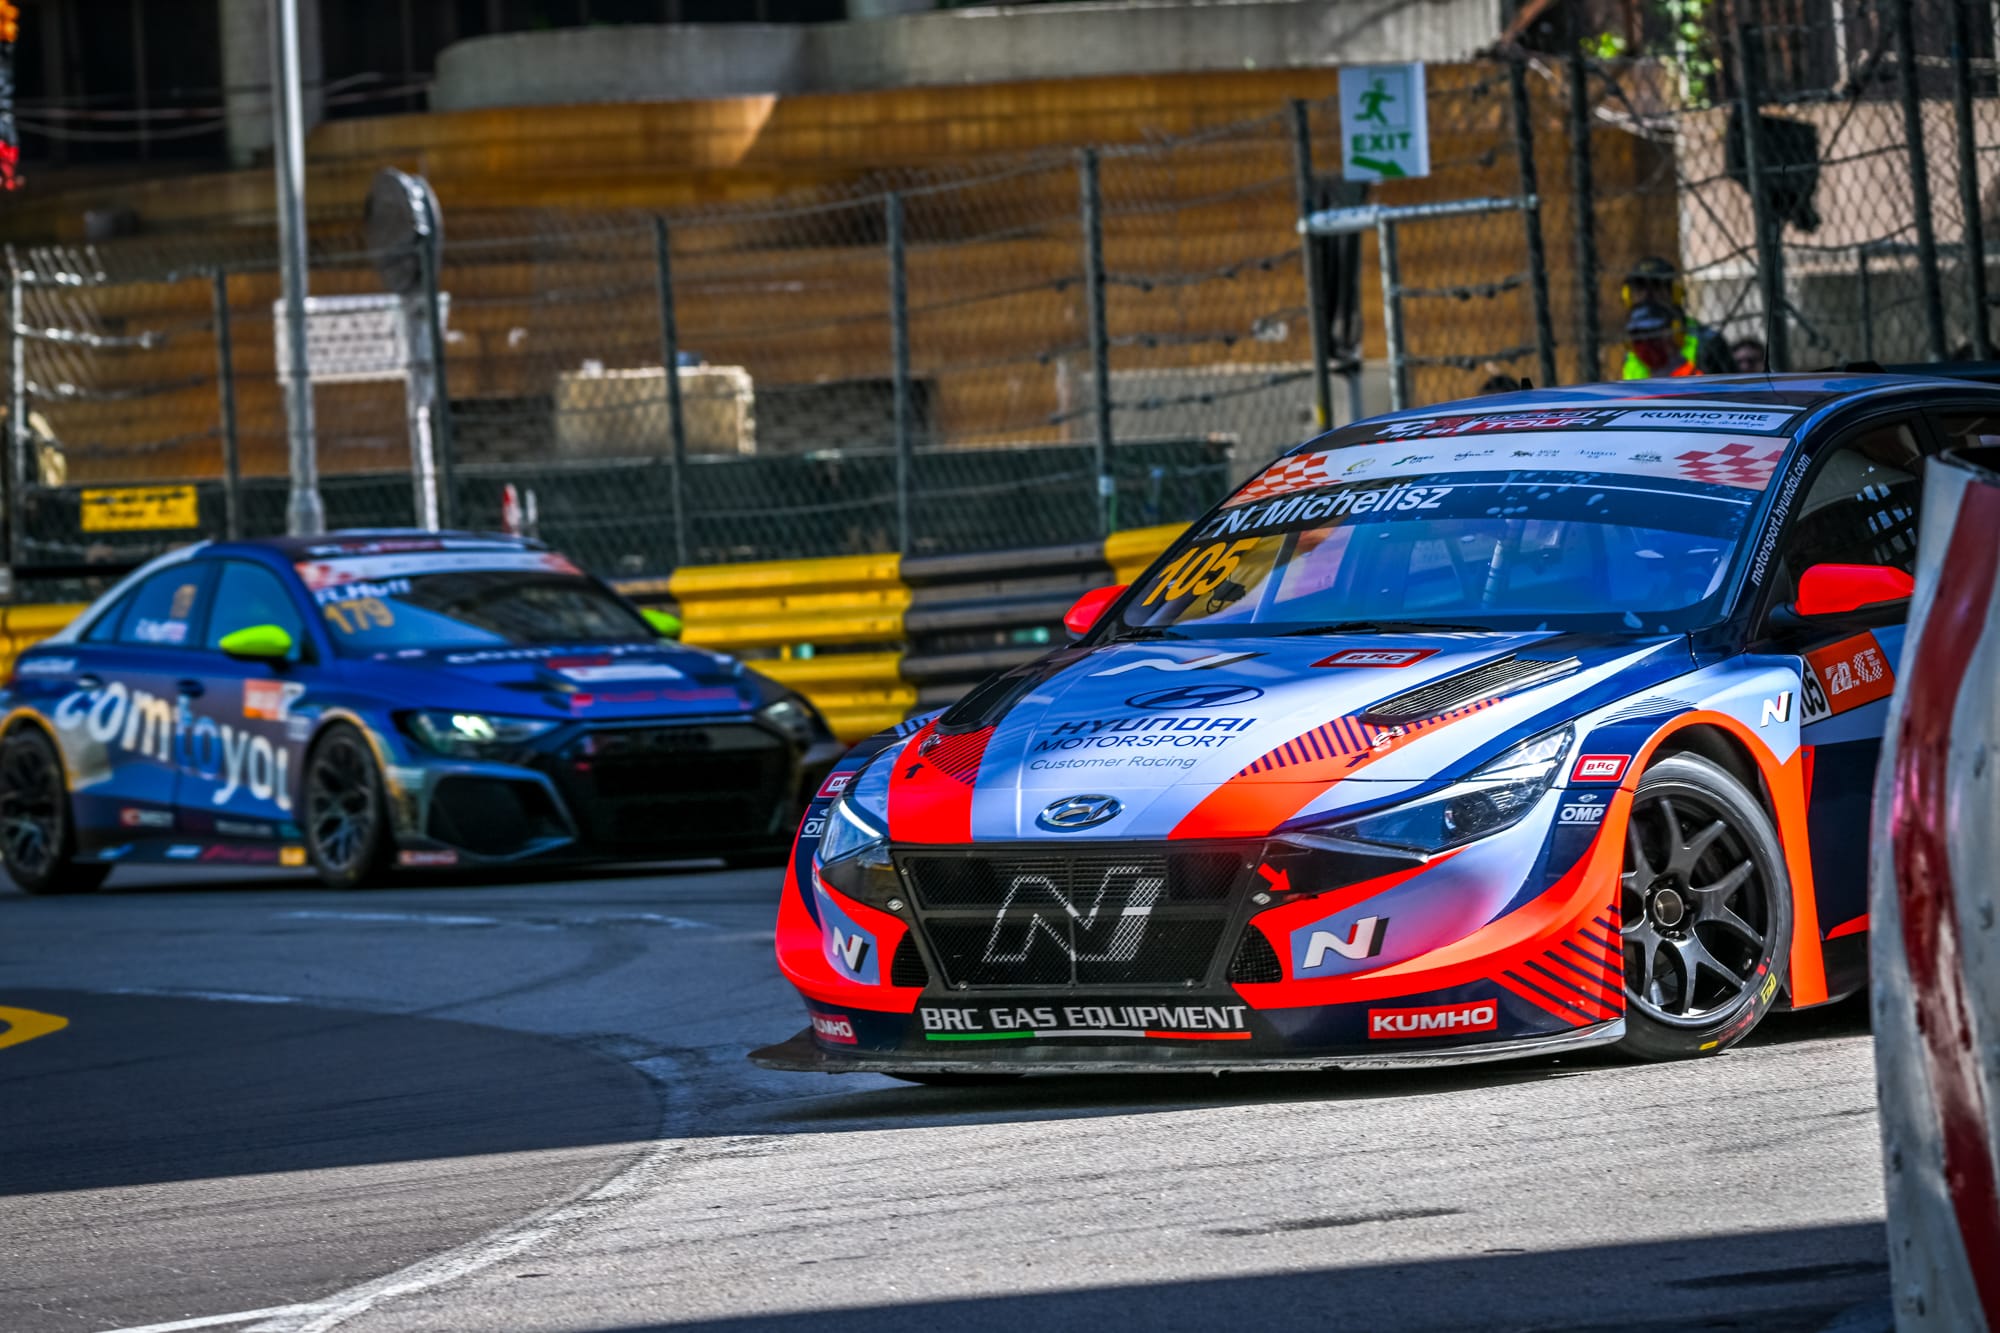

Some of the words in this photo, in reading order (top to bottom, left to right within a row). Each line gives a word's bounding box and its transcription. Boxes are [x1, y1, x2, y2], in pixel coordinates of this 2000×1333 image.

[1351, 131, 1411, 153] EXIT
[1486, 418, 1597, 429] TOUR
[1640, 411, 1723, 420] KUMHO
[1727, 413, 1769, 422] TIRE
[1211, 483, 1454, 538] N.Michelisz
[1750, 453, 1812, 587] motorsport.hyundai.com
[1141, 537, 1262, 607] 105
[324, 597, 395, 634] 179
[1050, 717, 1258, 736] HYUNDAI
[1034, 735, 1236, 751] MOTORSPORT
[1030, 757, 1126, 770] Customer
[1128, 756, 1198, 769] Racing
[1586, 762, 1615, 771] BRC
[1560, 807, 1605, 821] OMP
[1302, 915, 1390, 969] N
[920, 1007, 982, 1031] BRC
[990, 1007, 1057, 1029] GAS
[1063, 1005, 1247, 1029] EQUIPMENT
[1373, 1006, 1494, 1032] KUMHO
